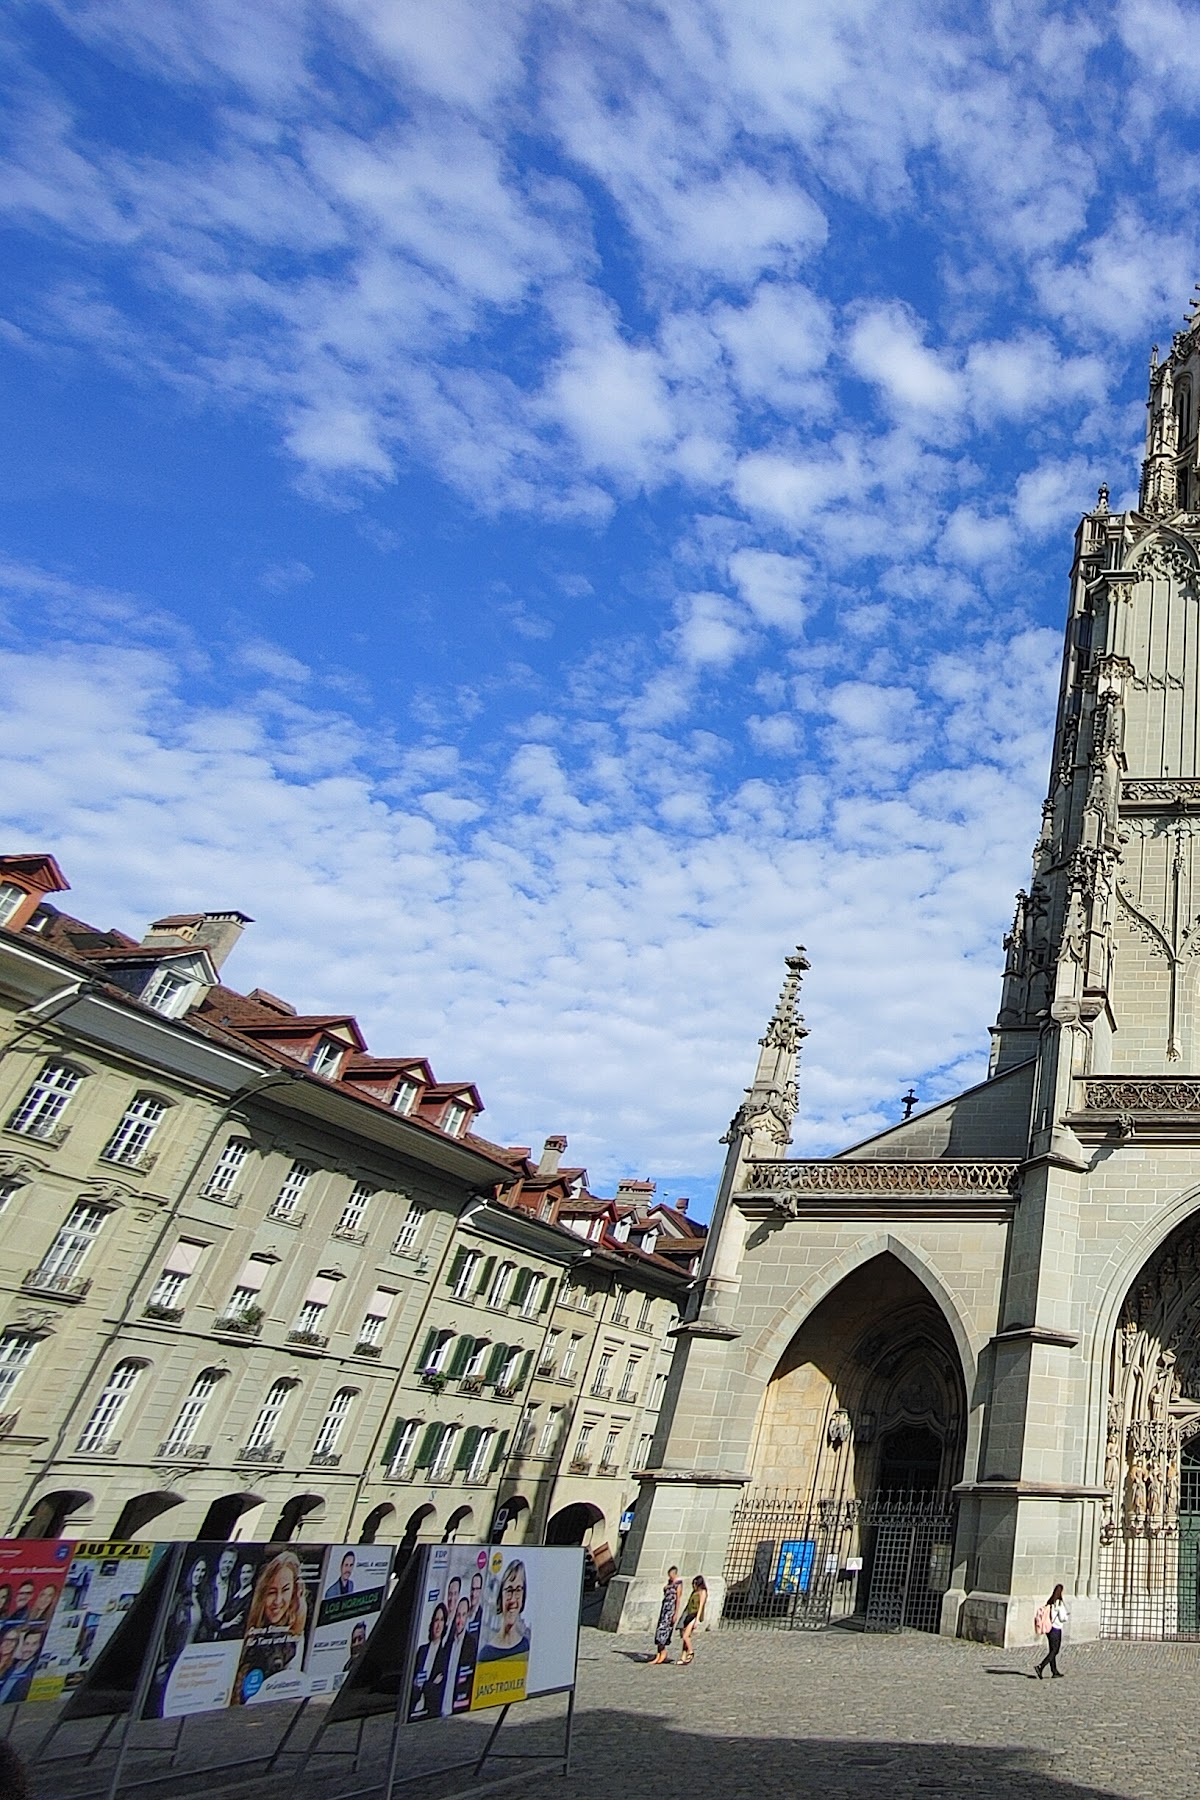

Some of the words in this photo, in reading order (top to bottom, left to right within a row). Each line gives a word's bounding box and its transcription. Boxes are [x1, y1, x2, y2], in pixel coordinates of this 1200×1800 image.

[75, 1543, 141, 1555] JUTZI
[435, 1550, 448, 1558] FDP
[324, 1601, 341, 1615] LOS
[475, 1678, 525, 1699] JANS-TROXLER
